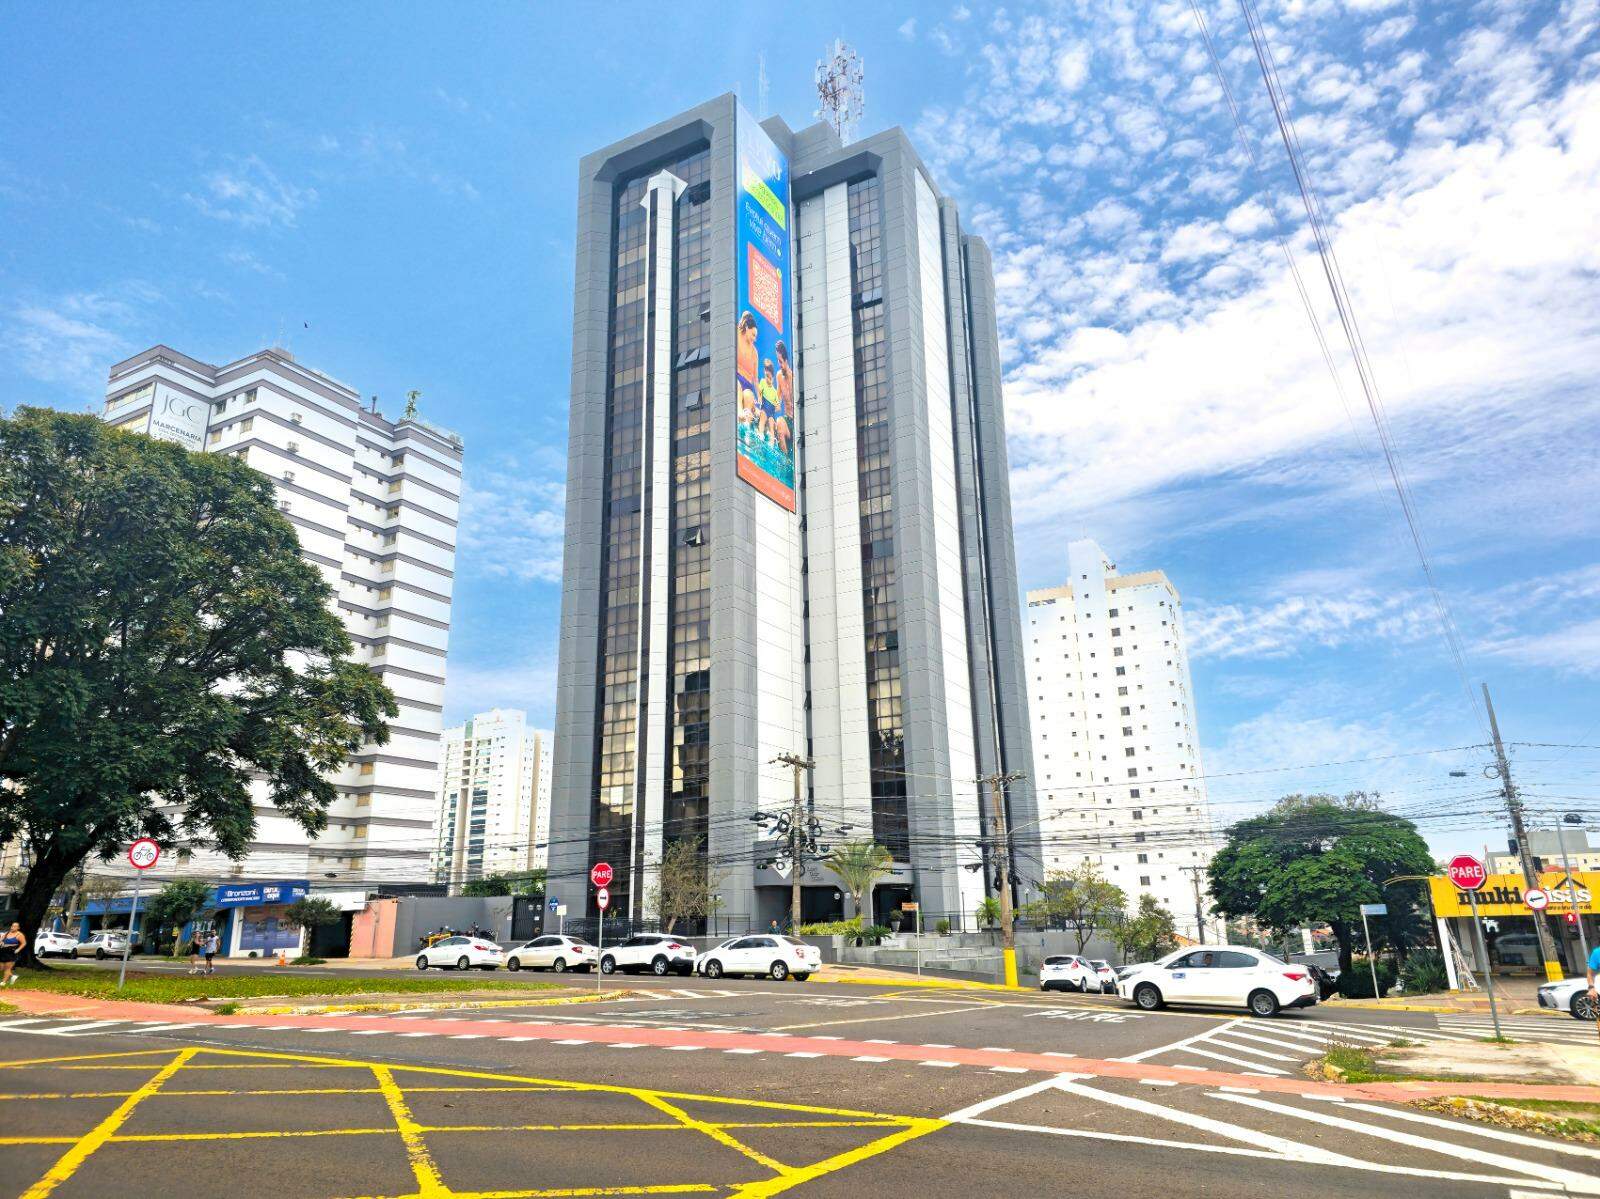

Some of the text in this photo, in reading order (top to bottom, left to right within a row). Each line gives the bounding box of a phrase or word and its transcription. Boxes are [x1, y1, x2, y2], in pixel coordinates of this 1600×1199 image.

[153, 420, 202, 442] MARCENARIA
[1451, 866, 1483, 878] PARE
[1022, 1010, 1146, 1023] PARE
